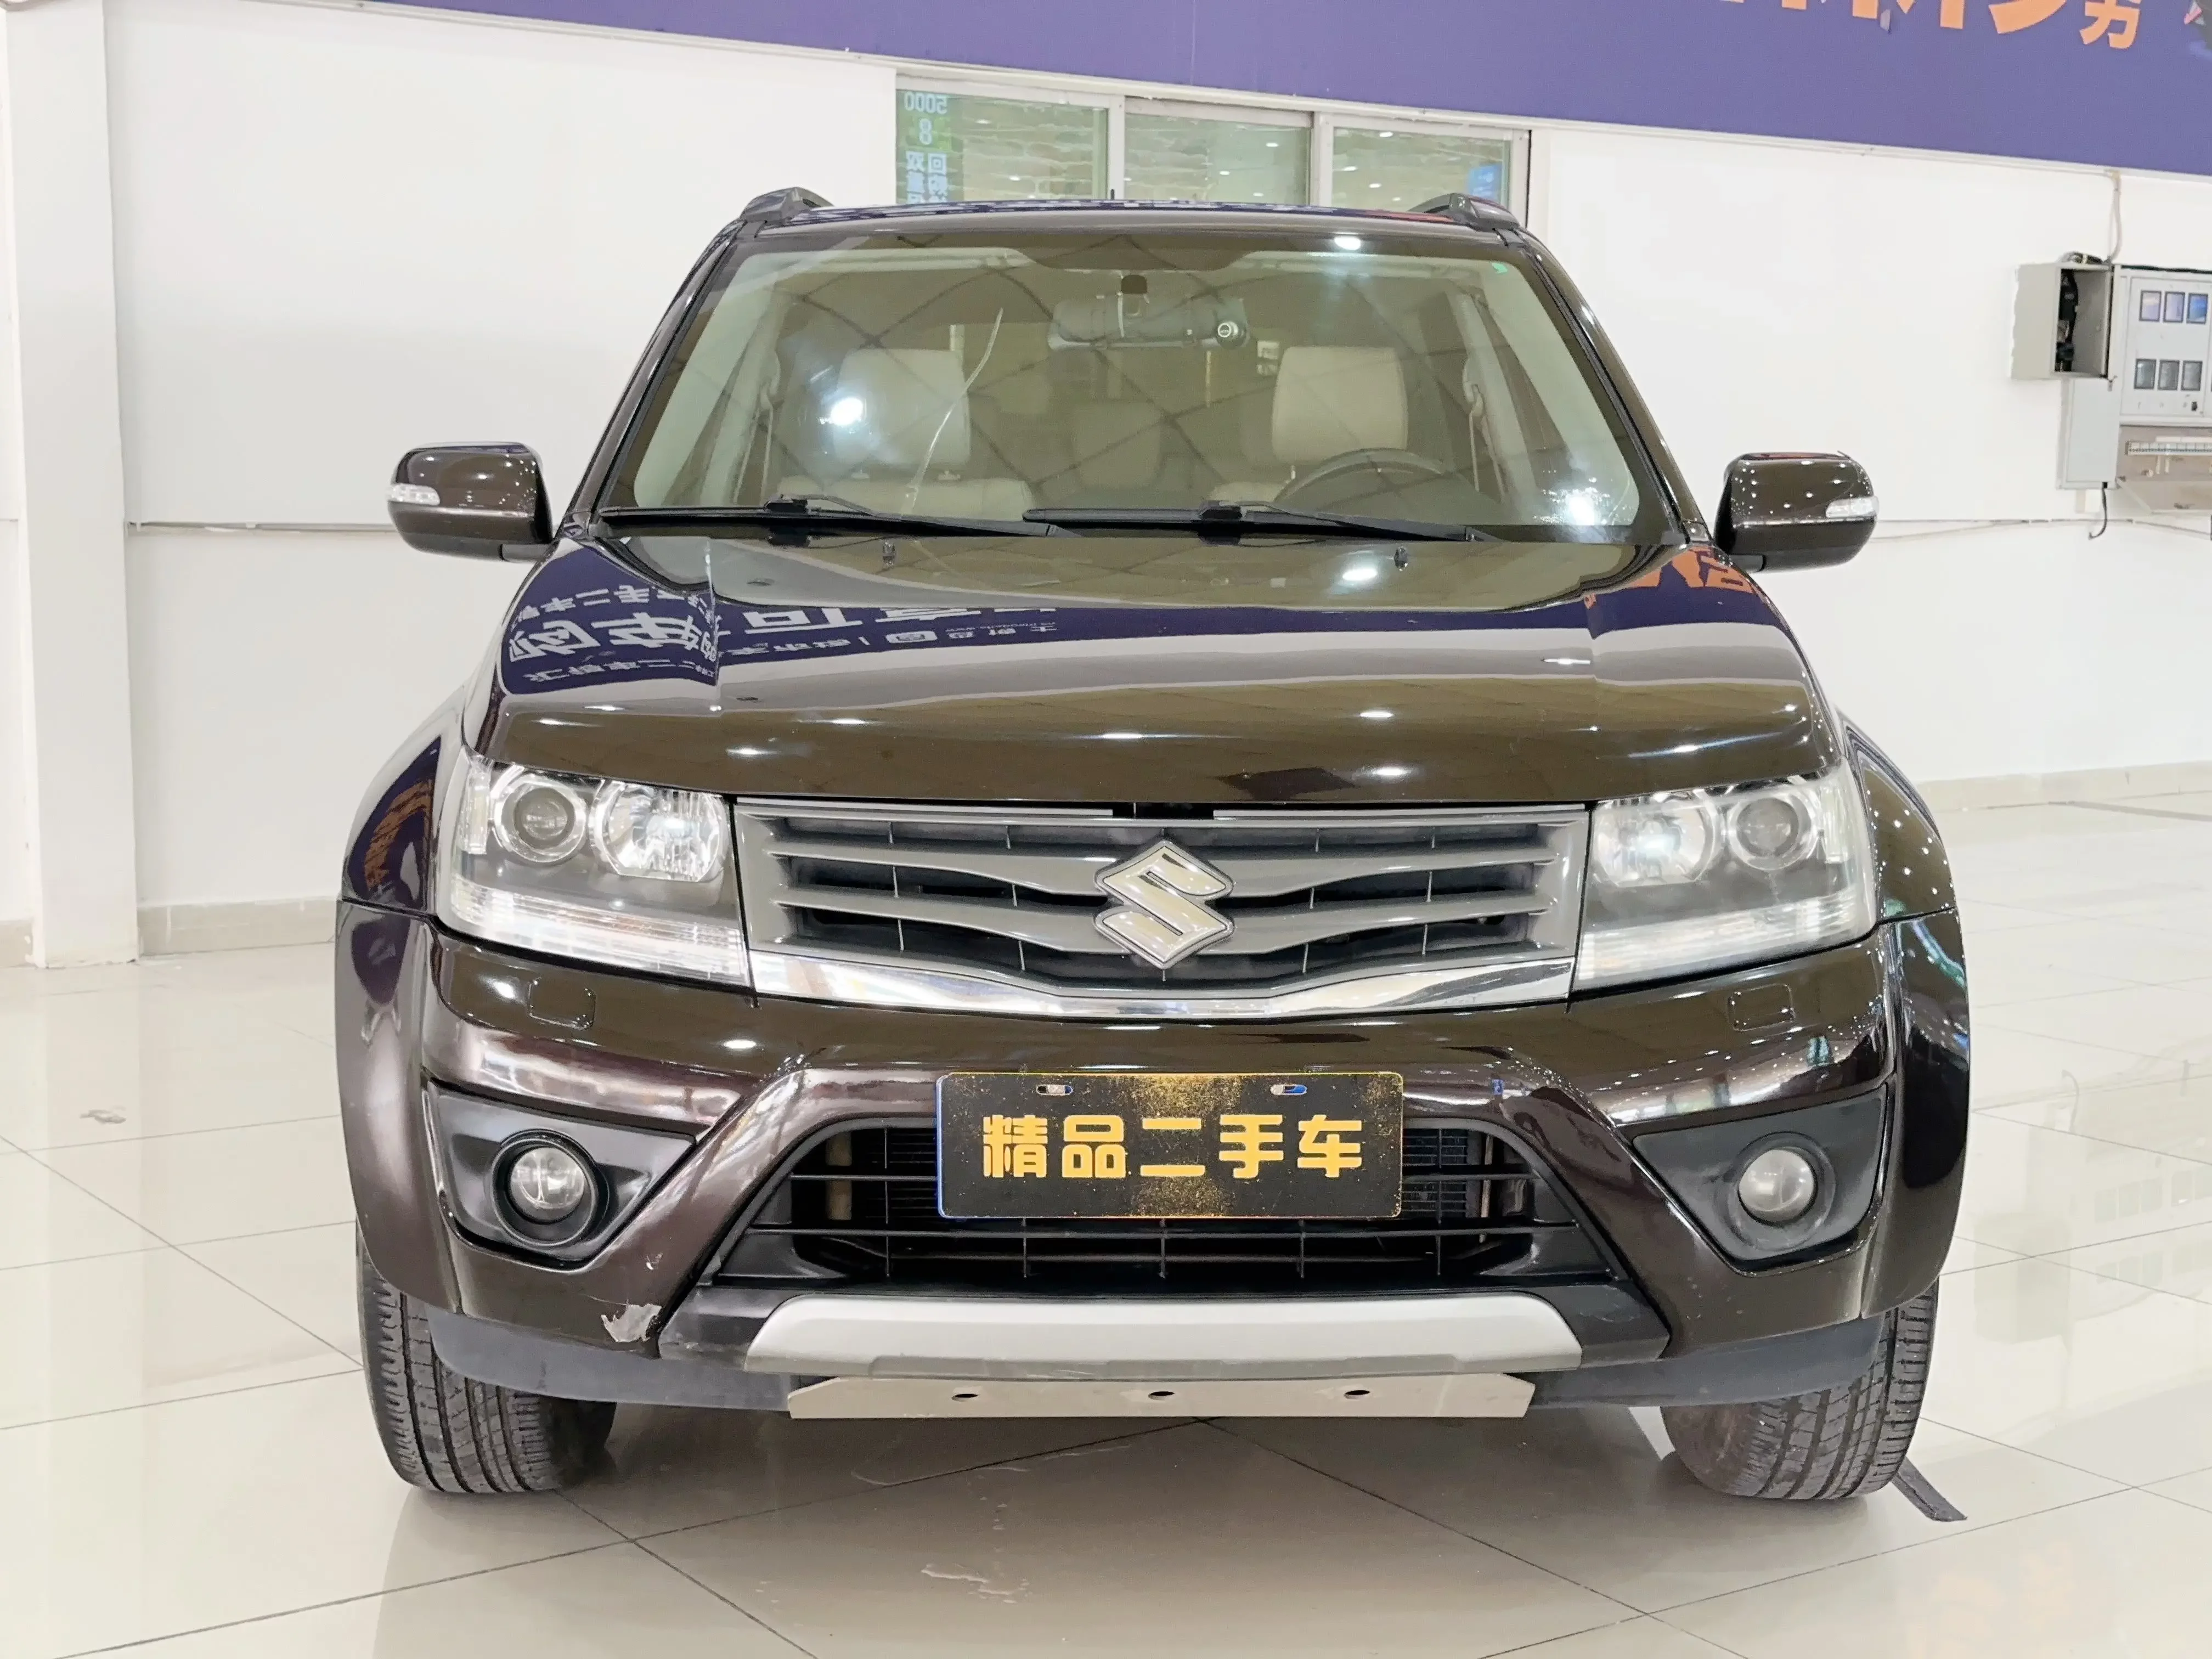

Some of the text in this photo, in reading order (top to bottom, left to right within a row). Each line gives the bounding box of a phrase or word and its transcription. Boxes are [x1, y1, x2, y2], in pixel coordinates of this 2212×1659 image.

[983, 1114, 1363, 1179] 精品二手车
